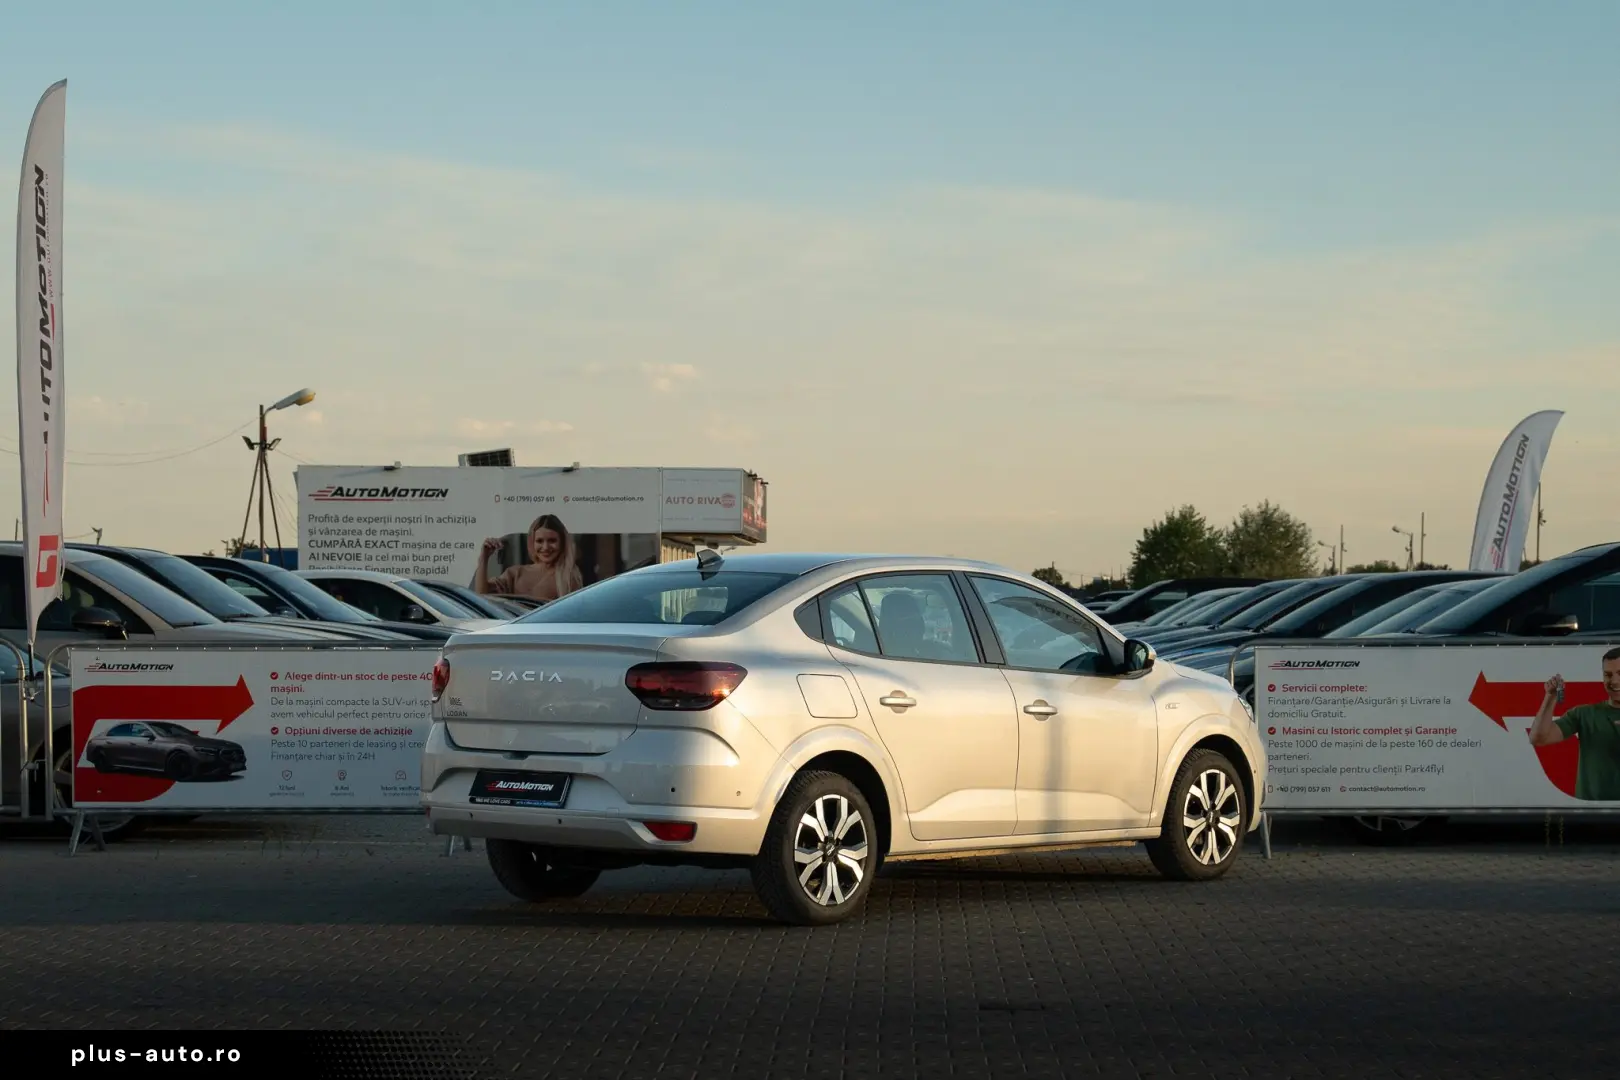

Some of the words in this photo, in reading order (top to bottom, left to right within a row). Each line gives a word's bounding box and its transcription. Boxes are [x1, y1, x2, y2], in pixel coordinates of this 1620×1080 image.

[665, 496, 694, 505] AUTO
[698, 496, 721, 505] RIVA
[308, 514, 339, 524] Profită
[342, 515, 354, 524] de
[357, 514, 392, 526] experții
[395, 515, 422, 526] noștri
[436, 514, 477, 526] achiziția
[308, 528, 316, 538] și
[318, 527, 363, 536] vânzarea
[365, 527, 377, 536] de
[380, 528, 414, 538] mașini.
[308, 538, 362, 549] CUMPĂRĂ
[364, 540, 400, 549] EXACT
[401, 541, 437, 551] mașina
[440, 541, 451, 549] de
[454, 542, 475, 550] care
[309, 553, 320, 561] AI
[322, 552, 362, 561] NEVOIE
[364, 552, 373, 561] la
[376, 552, 389, 561] cel
[392, 552, 409, 561] mai
[412, 552, 431, 561] bun
[413, 565, 449, 577] Rapidă!
[285, 672, 313, 682] Alege
[315, 672, 352, 681] dintr-un
[355, 672, 376, 681] stoc
[378, 672, 389, 681] de
[392, 673, 417, 682] peste
[490, 670, 563, 683] DACIA
[270, 685, 305, 695] mașini.
[1282, 684, 1317, 692] Servicii
[1319, 684, 1367, 695] complete:
[271, 697, 284, 706] De
[286, 697, 293, 706] la
[296, 697, 324, 708] mașini
[326, 698, 370, 708] compacte
[372, 697, 379, 706] la
[382, 697, 417, 706] SUV-uri
[1401, 697, 1407, 707] și
[1410, 696, 1441, 705] Livrare
[1443, 696, 1451, 705] la
[296, 710, 334, 719] vehiculul
[338, 710, 369, 720] perfect
[372, 710, 401, 720] pentru
[403, 710, 425, 719] orice
[1268, 709, 1309, 718] domiciliu
[1311, 709, 1346, 718] Gratuit.
[285, 726, 320, 737] Opțiuni
[323, 726, 357, 735] diverse
[359, 726, 371, 735] de
[374, 726, 413, 737] achiziție
[1331, 727, 1361, 736] Istoric
[1364, 727, 1402, 738] complet
[1405, 727, 1412, 737] și
[1415, 726, 1457, 737] Garanție
[271, 740, 296, 748] Peste
[298, 740, 307, 748] 10
[310, 739, 350, 749] parteneri
[353, 739, 364, 748] de
[367, 739, 397, 750] leasing
[399, 739, 406, 750] și
[1268, 740, 1293, 748] Peste
[1296, 740, 1318, 748] 1000
[1320, 740, 1332, 748] de
[1335, 740, 1363, 750] mașini
[1365, 740, 1377, 748] de
[1380, 740, 1388, 748] la
[1390, 741, 1415, 750] peste
[1418, 740, 1433, 748] 160
[1436, 740, 1448, 748] de
[1450, 740, 1482, 748] dealeri
[271, 752, 312, 762] Finanțare
[314, 752, 336, 761] chiar
[338, 752, 345, 763] și
[357, 752, 375, 761] 24H
[1268, 753, 1311, 763] parteneri.
[1268, 764, 1298, 774] Prețuri
[1301, 765, 1337, 775] speciale
[1340, 766, 1370, 775] pentru
[1372, 764, 1402, 775] clienții
[1405, 764, 1444, 775] Park4fly!
[1290, 786, 1306, 794] (799)
